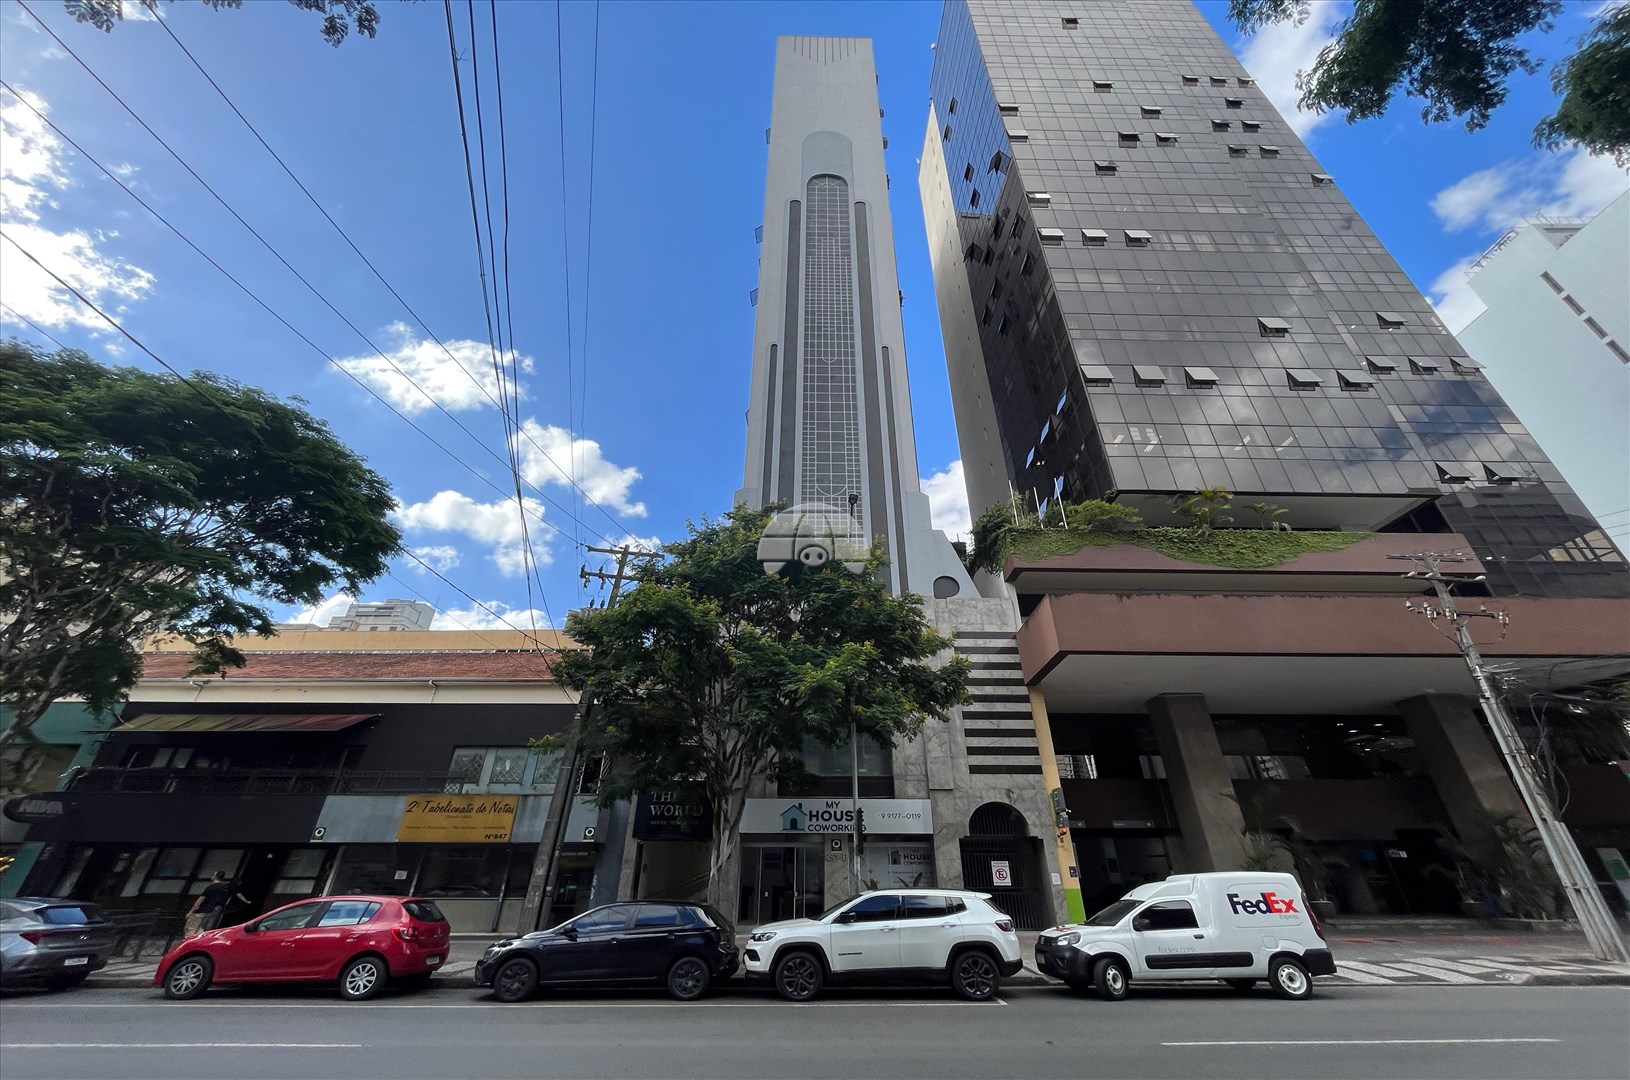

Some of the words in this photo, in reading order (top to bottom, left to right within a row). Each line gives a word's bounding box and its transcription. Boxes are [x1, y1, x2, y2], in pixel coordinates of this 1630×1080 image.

[421, 800, 474, 814] Tabelionato
[475, 802, 487, 814] de
[488, 801, 515, 814] Notas
[825, 801, 840, 809] MY
[807, 824, 867, 832] COWORKIG
[1226, 891, 1300, 915] FedEx
